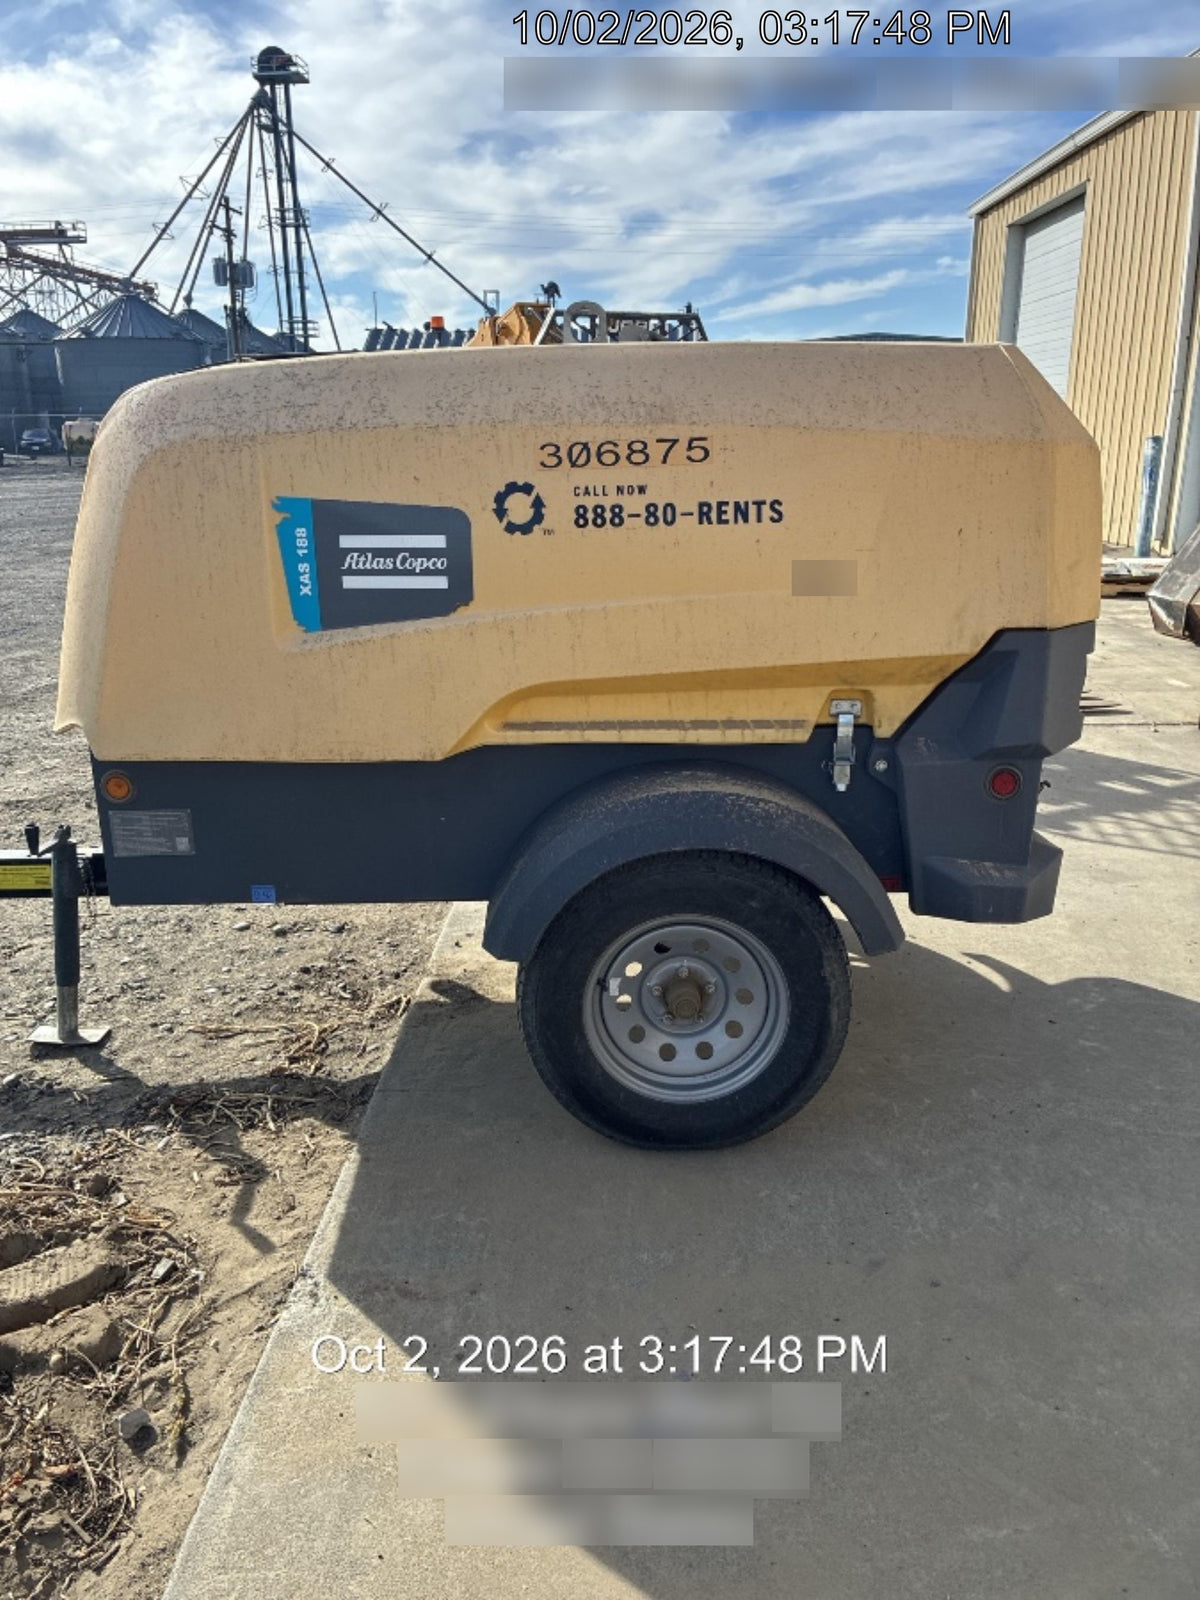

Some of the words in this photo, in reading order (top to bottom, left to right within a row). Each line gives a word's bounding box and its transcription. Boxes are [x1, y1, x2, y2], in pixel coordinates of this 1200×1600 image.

[538, 436, 711, 469] 306875
[573, 485, 609, 497] CALL
[616, 484, 648, 496] NOW
[573, 499, 784, 528] 888-80-RENTS
[294, 527, 309, 557] 188
[340, 552, 394, 570] Atlas
[395, 552, 448, 573] Copco
[298, 562, 312, 596] XAS
